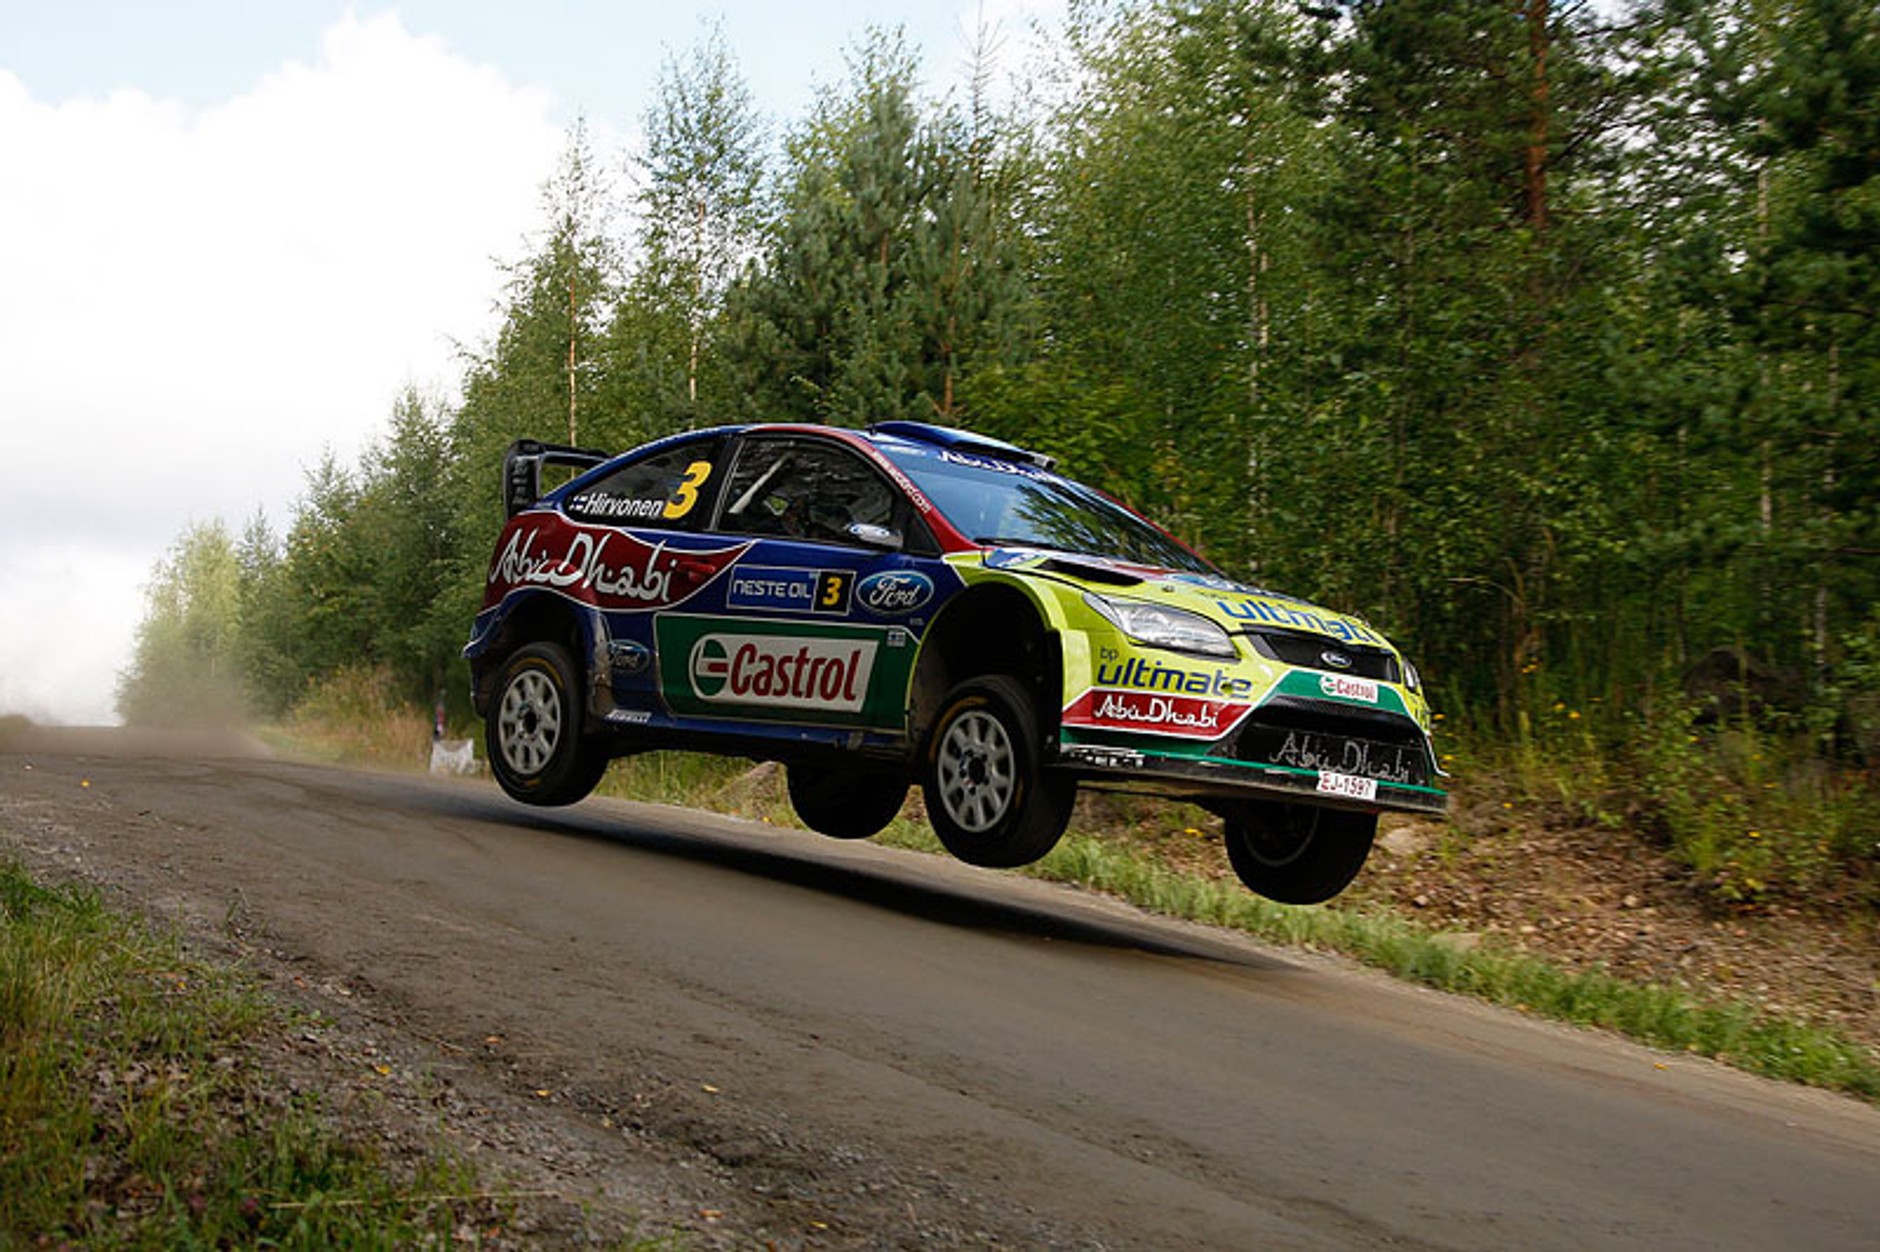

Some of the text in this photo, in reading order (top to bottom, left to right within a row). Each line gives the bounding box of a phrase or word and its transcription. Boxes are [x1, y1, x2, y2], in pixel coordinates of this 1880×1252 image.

[582, 460, 713, 520] Hirvonen 3
[554, 530, 679, 603] Dhabi
[788, 581, 812, 599] OIL
[822, 576, 843, 606] 3
[869, 575, 922, 608] Ford
[731, 643, 862, 701] Castrol
[1097, 658, 1253, 699] ultimate
